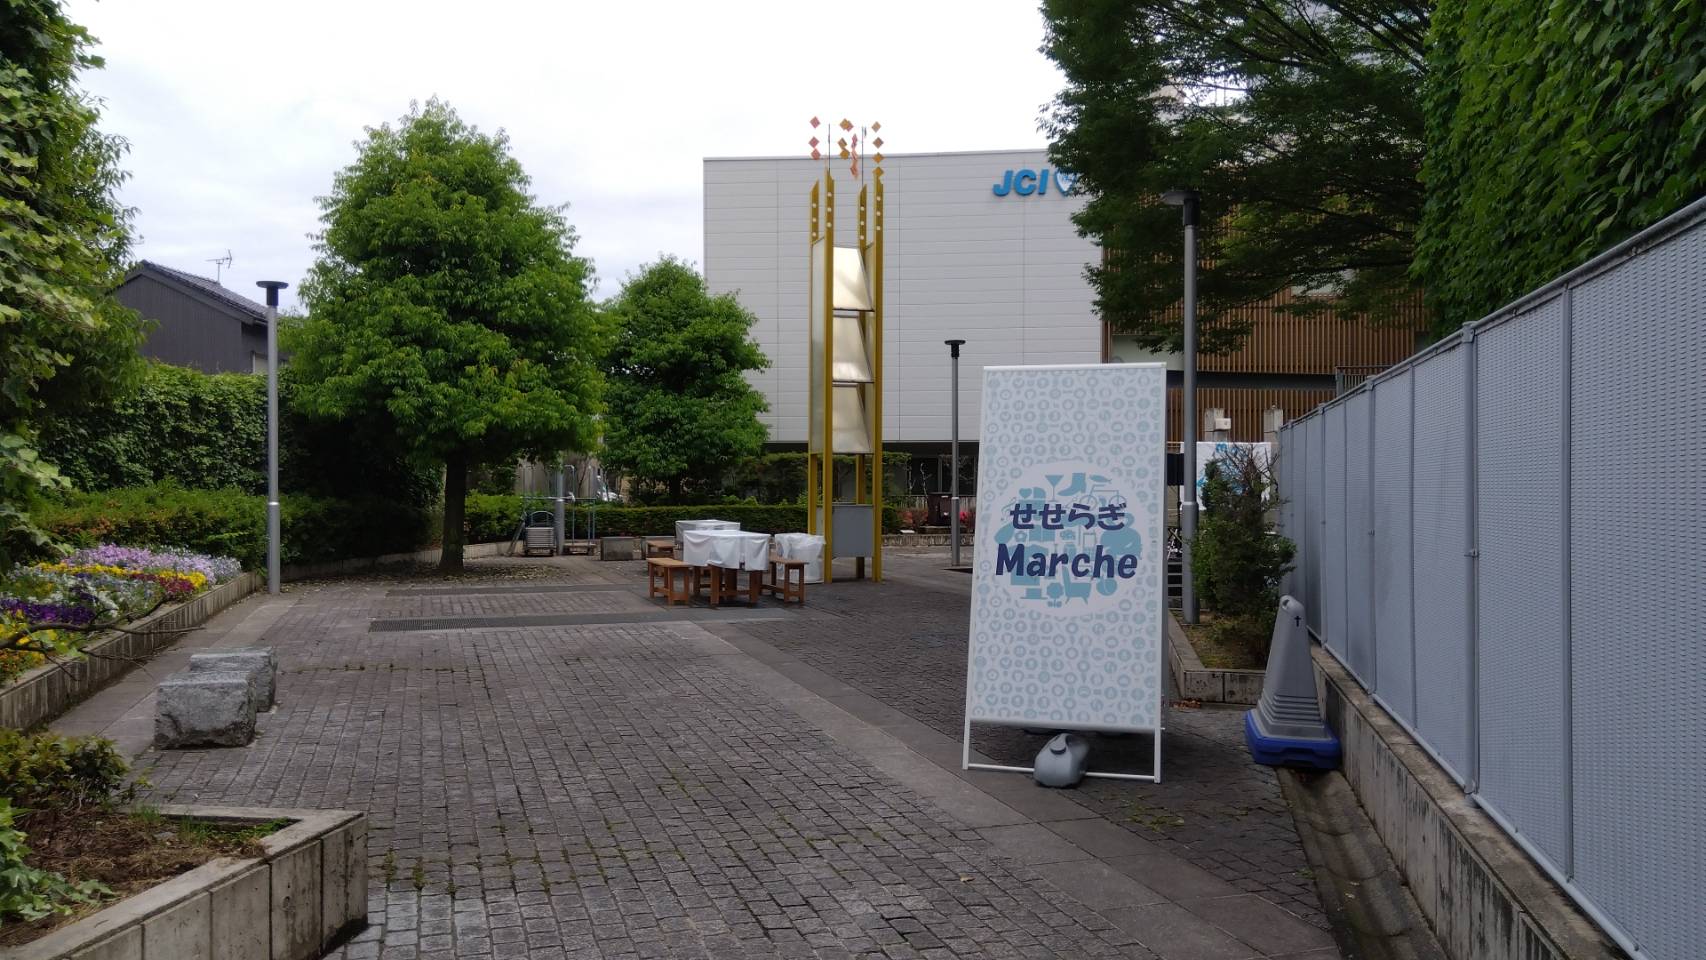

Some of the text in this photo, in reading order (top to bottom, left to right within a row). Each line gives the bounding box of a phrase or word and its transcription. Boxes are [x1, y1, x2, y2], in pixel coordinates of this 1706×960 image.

[992, 168, 1050, 197] JCI
[1010, 502, 1127, 531] せせらぎ
[996, 543, 1138, 579] Marche
